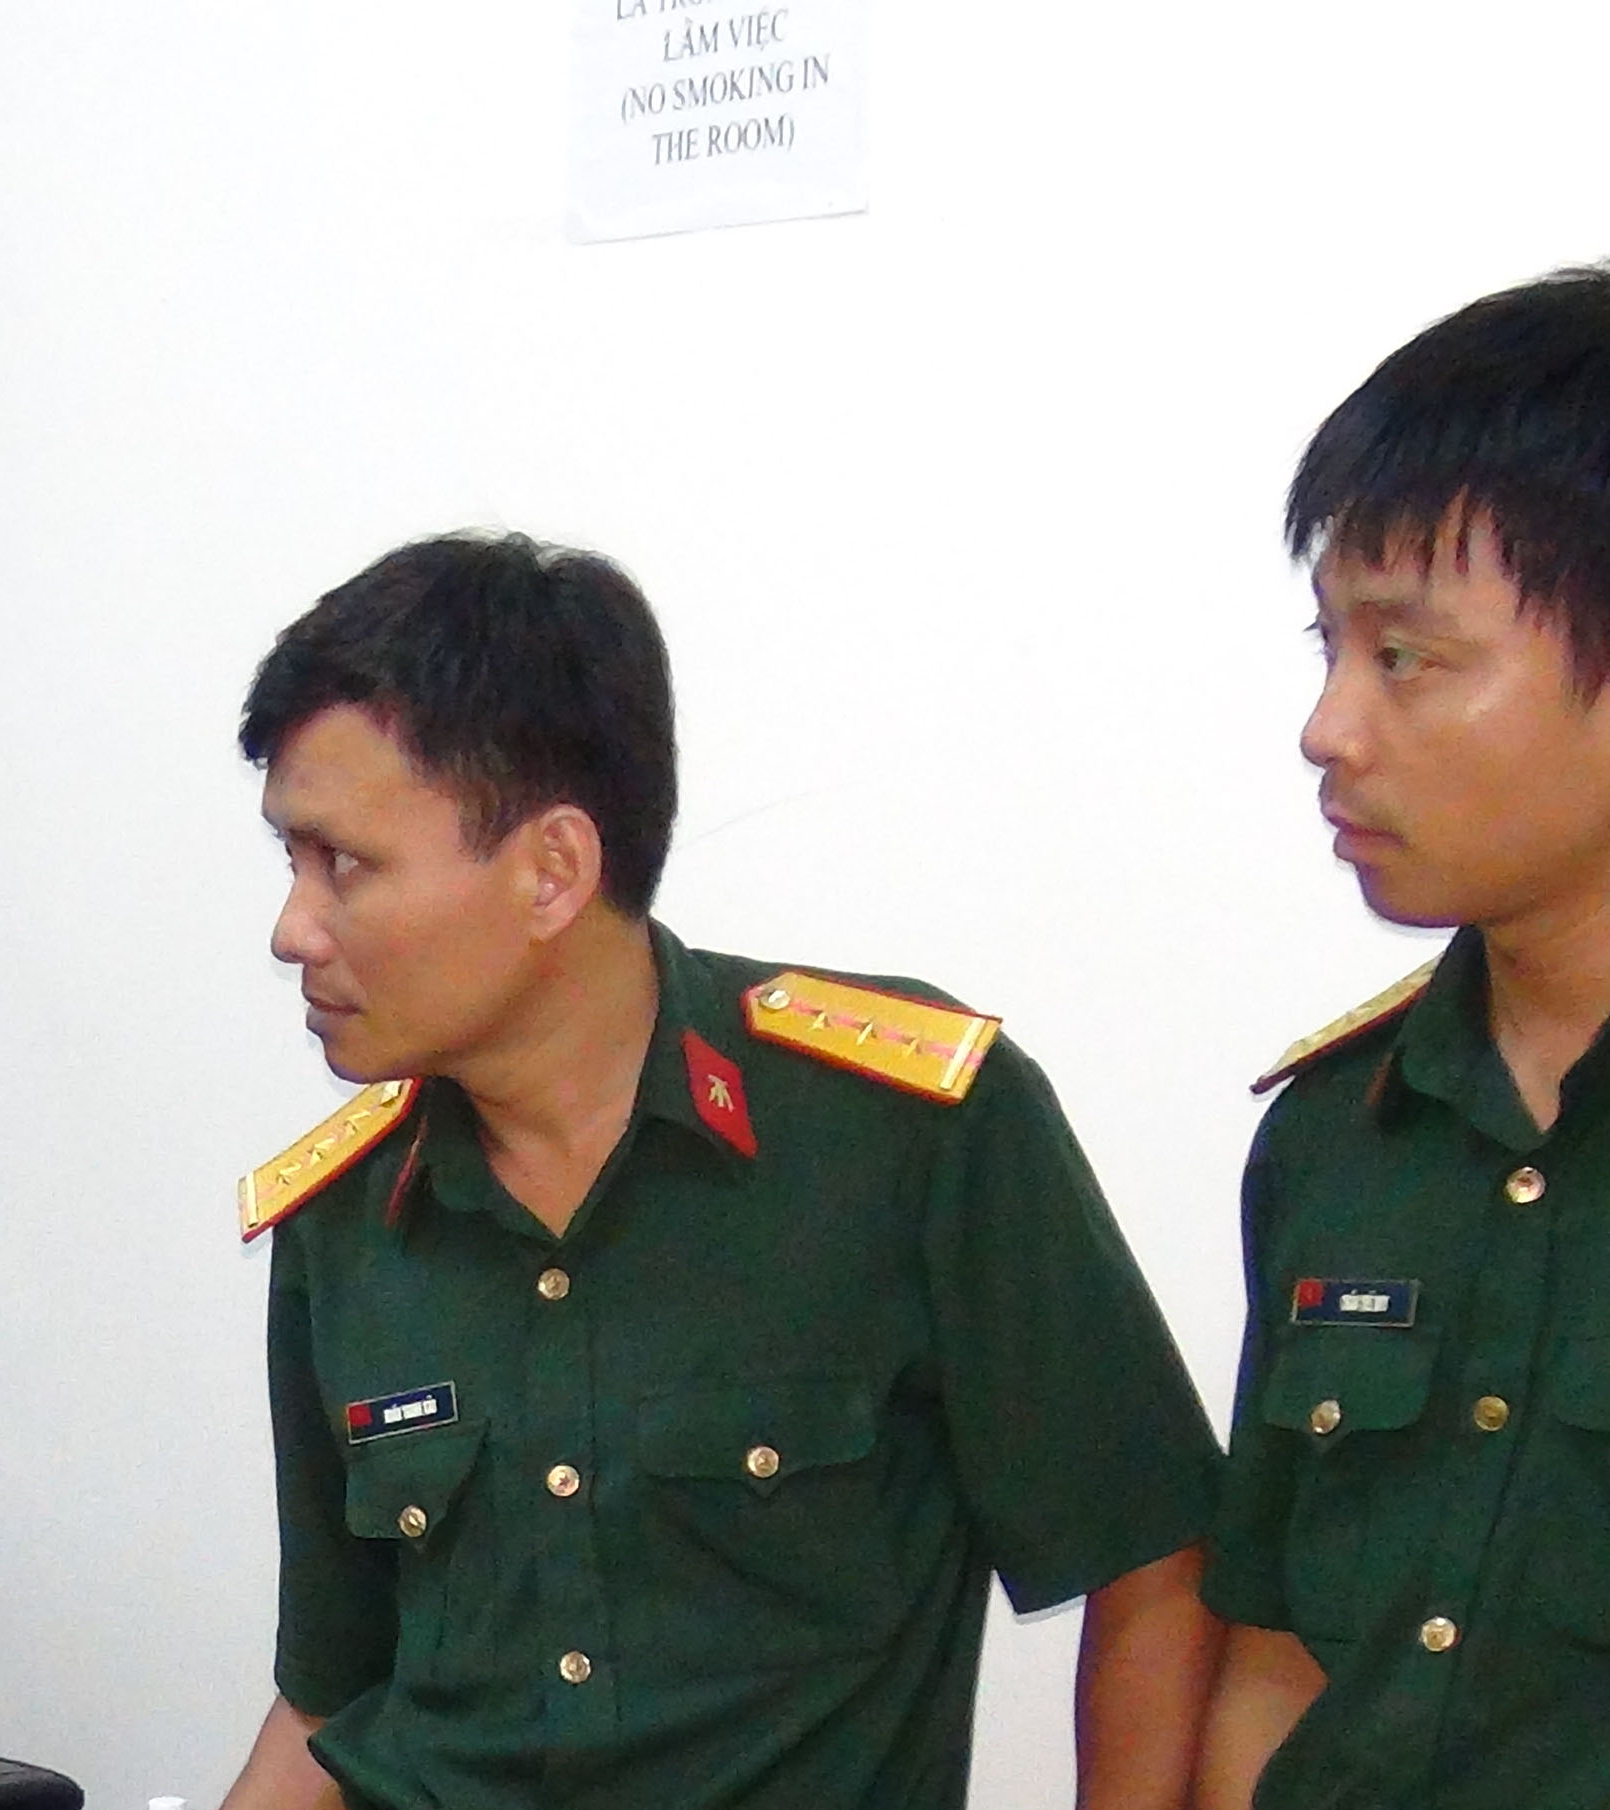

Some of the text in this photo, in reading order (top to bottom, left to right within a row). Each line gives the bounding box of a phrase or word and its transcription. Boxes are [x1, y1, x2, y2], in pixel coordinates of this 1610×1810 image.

[663, 7, 789, 62] LÀM VIỆC
[621, 53, 831, 126] (NO SMOKING IN
[652, 112, 795, 166] THE ROOM)
